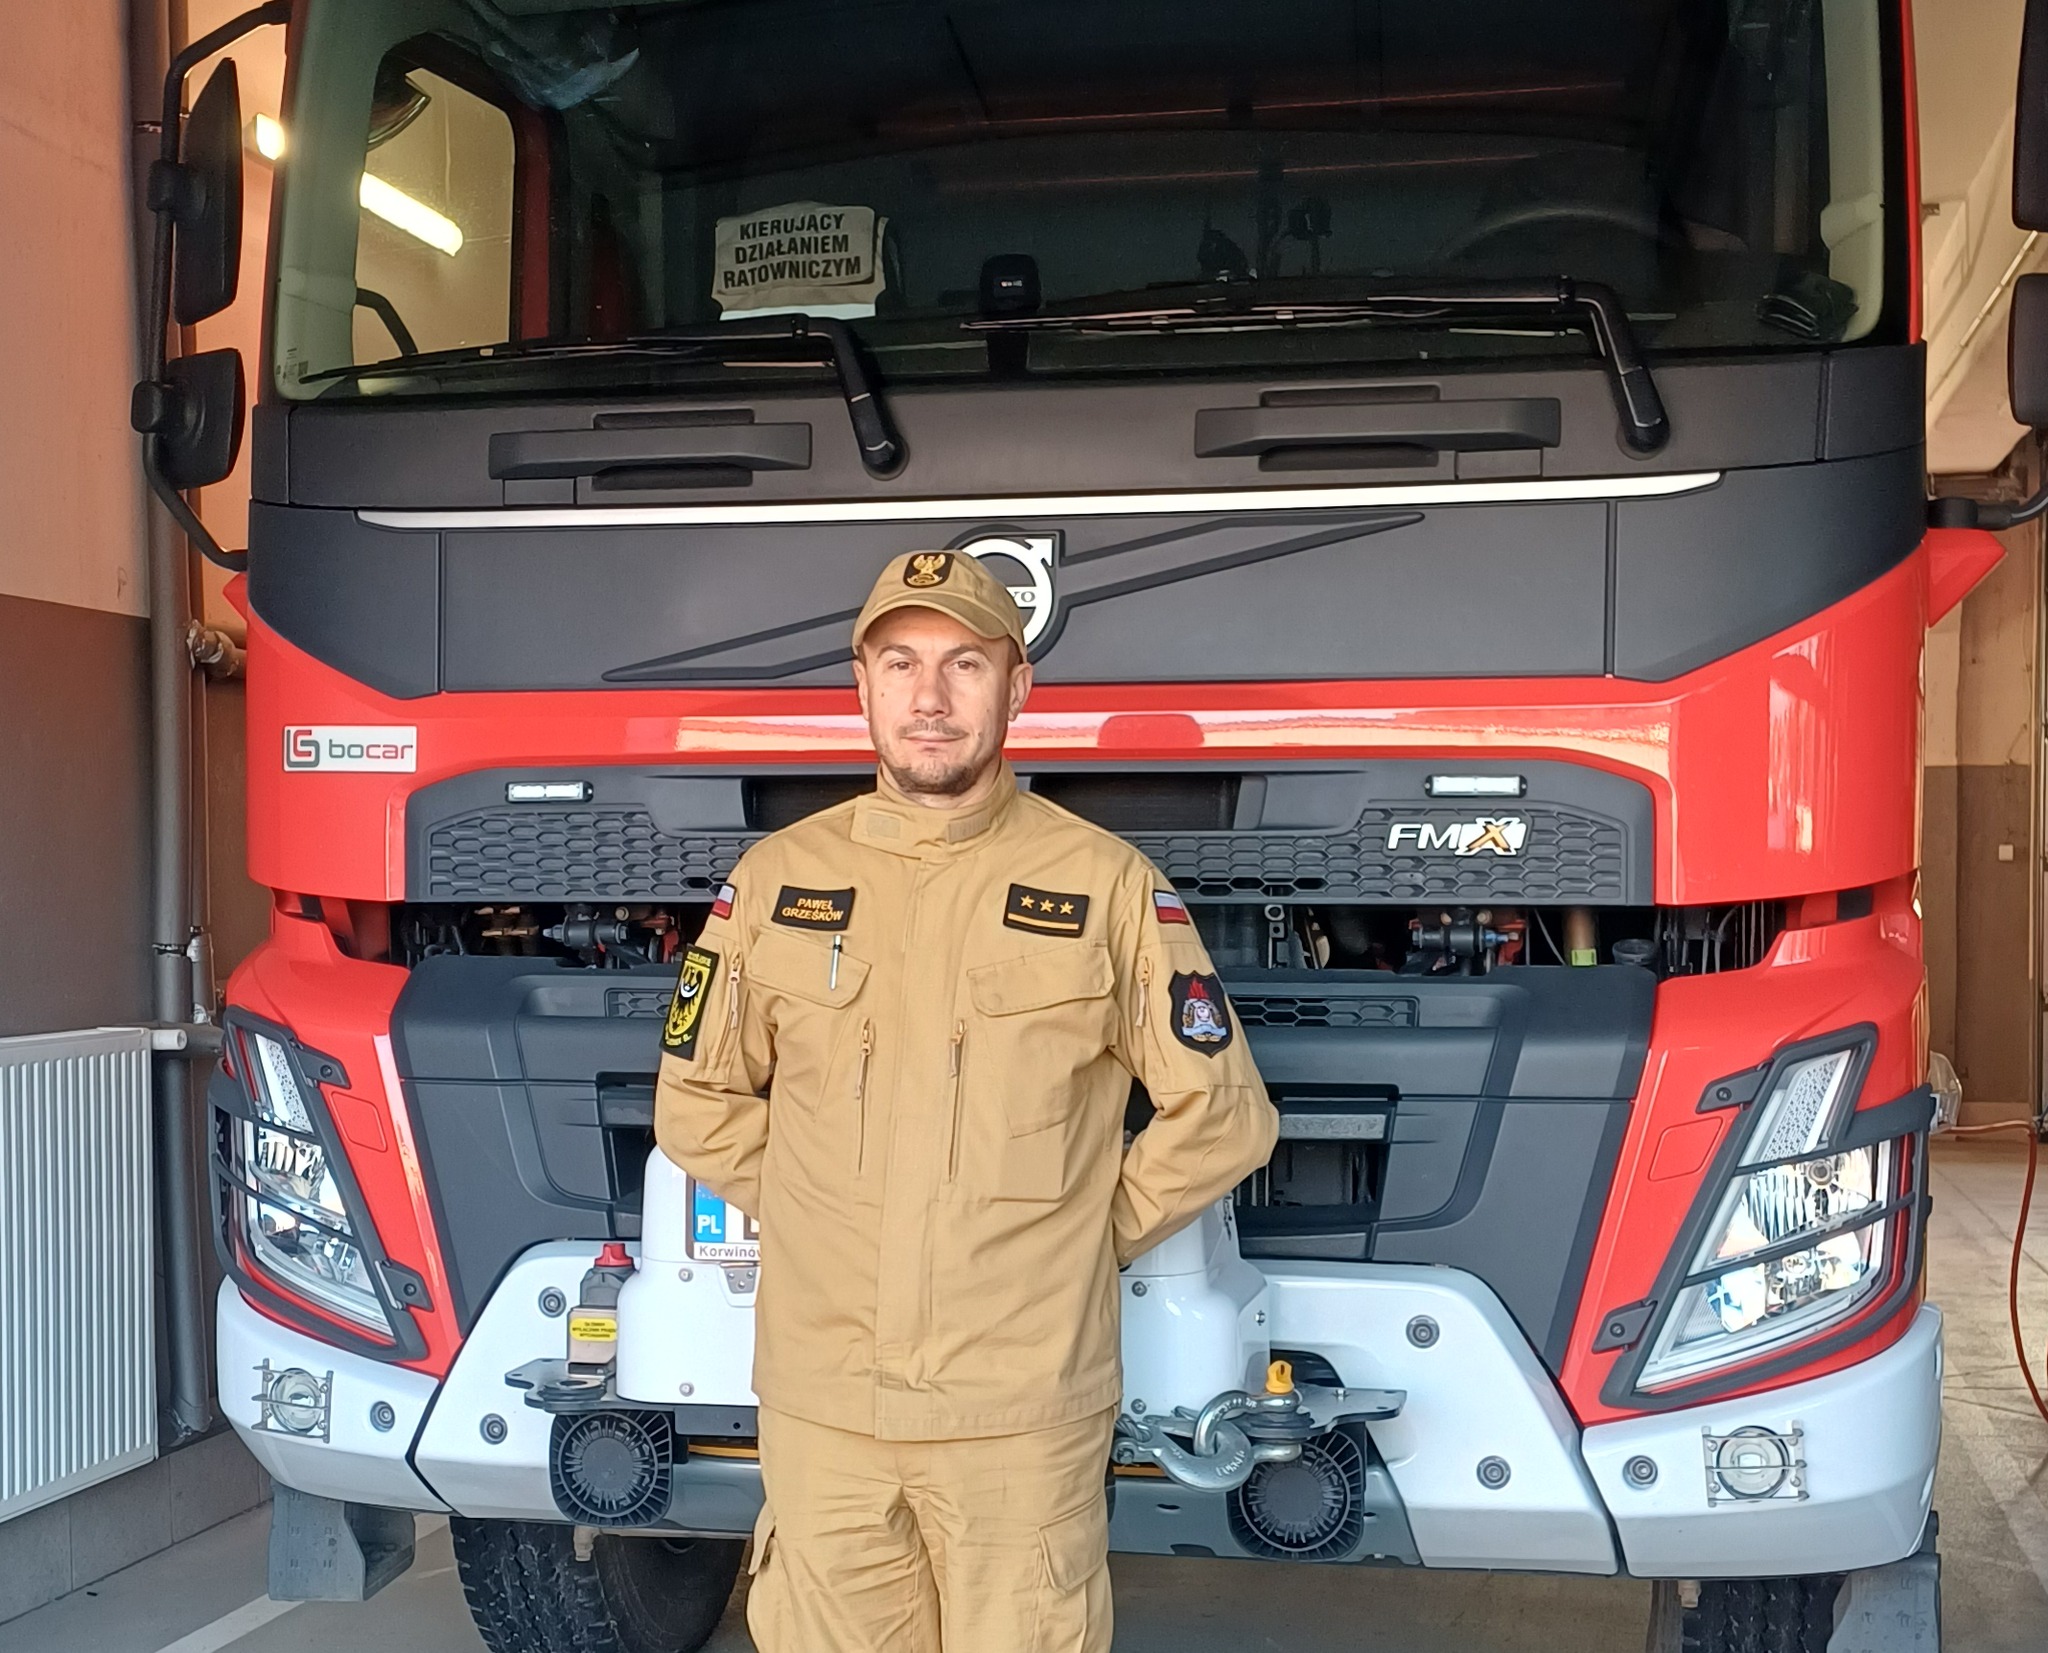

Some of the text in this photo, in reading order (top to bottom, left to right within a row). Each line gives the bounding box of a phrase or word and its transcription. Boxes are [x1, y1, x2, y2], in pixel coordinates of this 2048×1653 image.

[739, 213, 845, 241] KIERUJĄCY
[735, 234, 849, 265] DZIAŁANIEM
[723, 256, 861, 289] RATOWNICZYM
[328, 739, 413, 759] bocar
[1387, 817, 1527, 856] FMX
[782, 906, 844, 922] GRZEŚKÓW
[797, 898, 833, 911] PAWEŁ
[697, 1214, 722, 1234] PL
